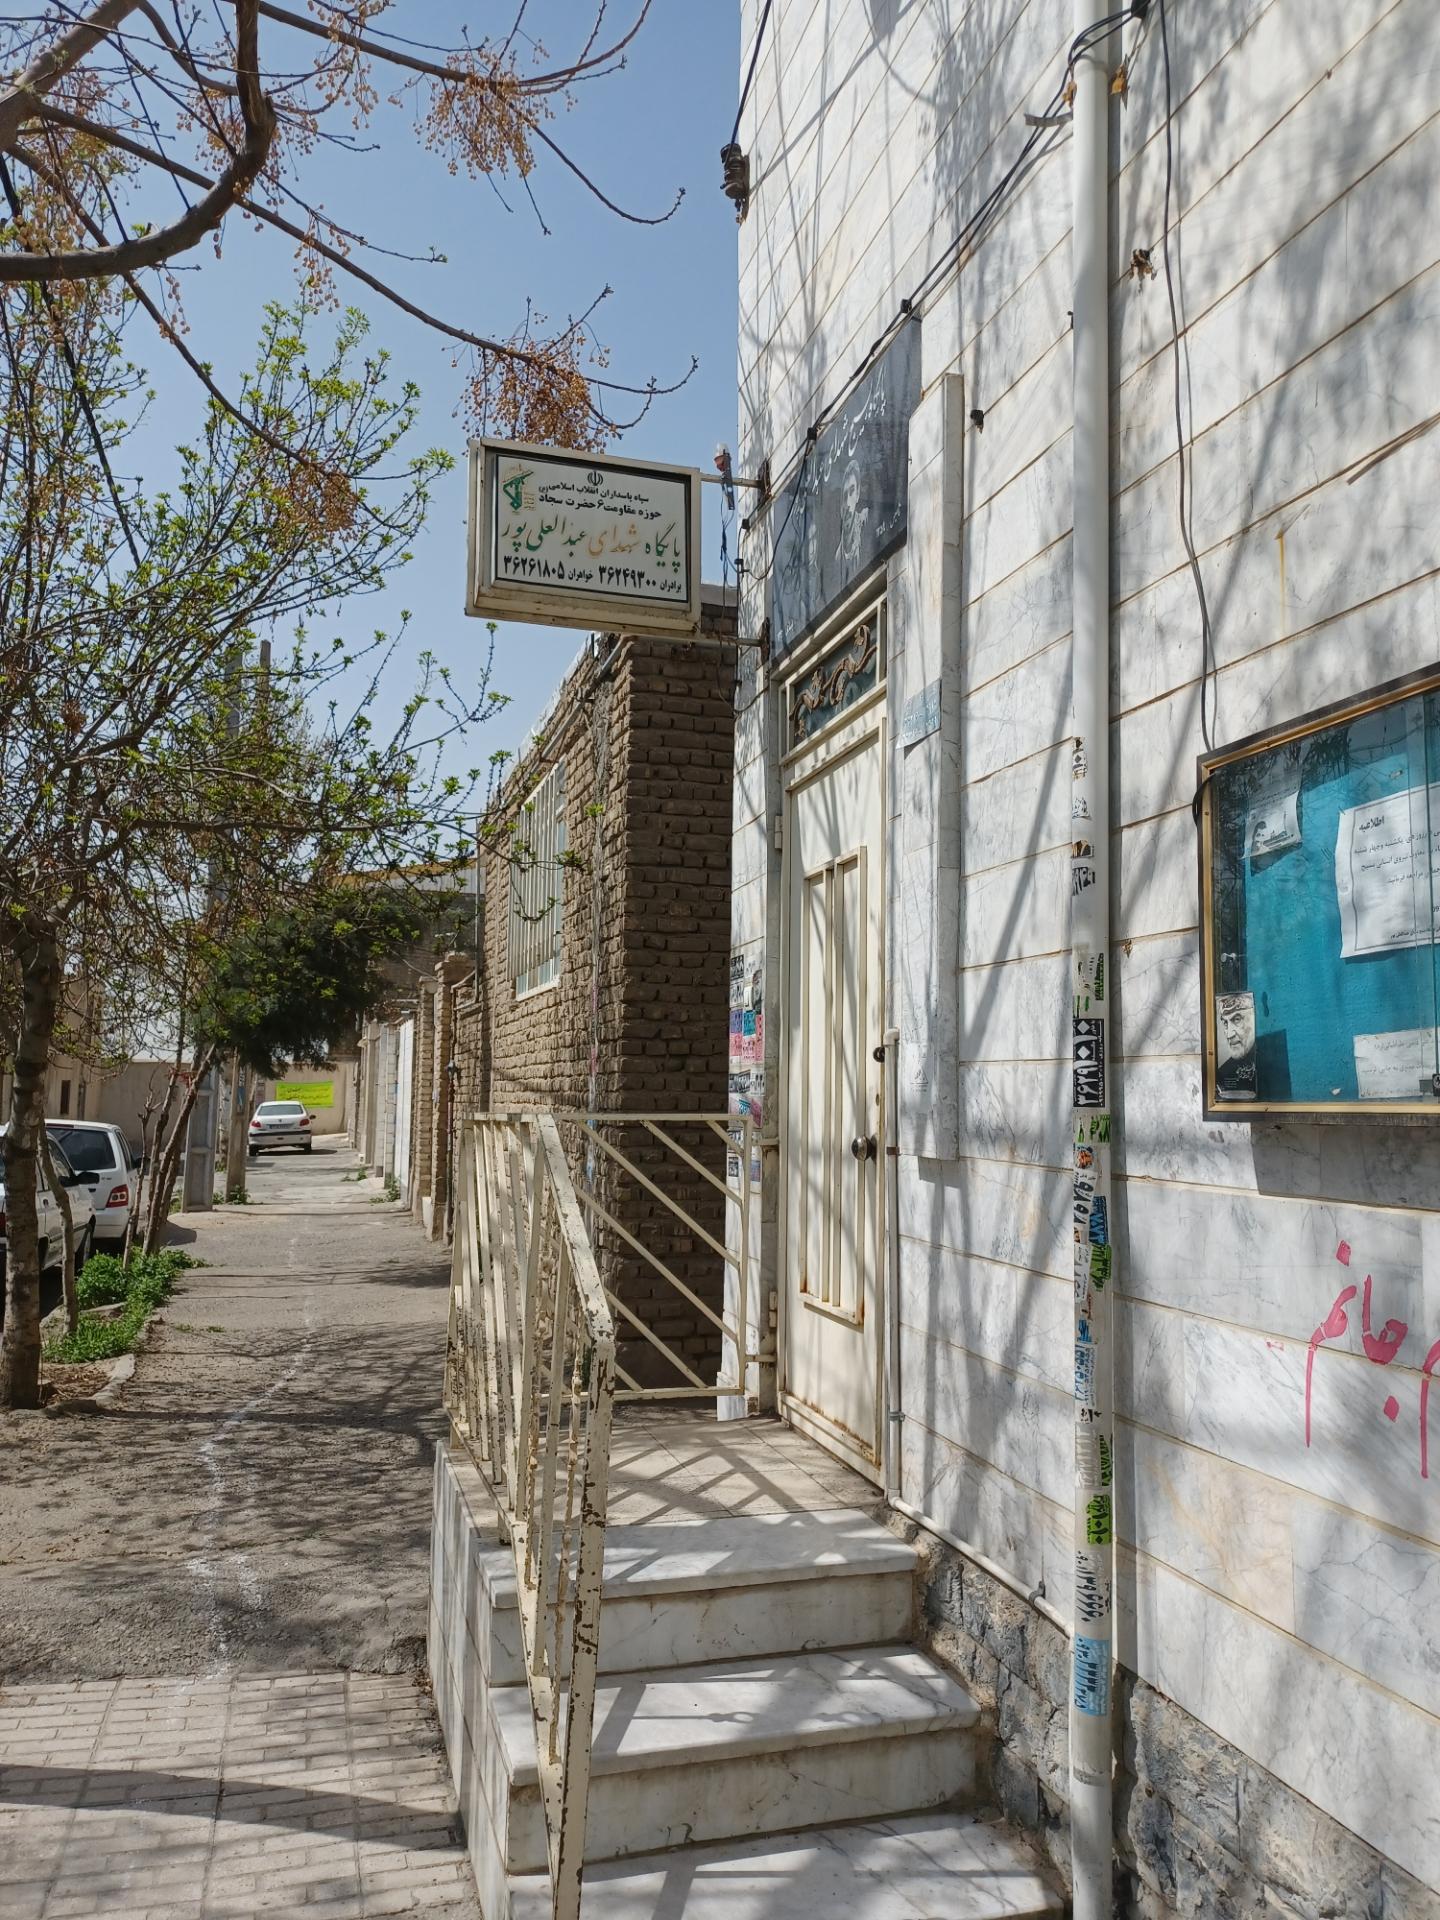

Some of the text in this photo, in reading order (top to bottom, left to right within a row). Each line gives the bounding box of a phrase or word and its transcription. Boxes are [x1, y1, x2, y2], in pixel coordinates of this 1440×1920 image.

[538, 493, 563, 507] سجاد
[548, 482, 649, 504] سپاه پاسداران انقلاب اسلامی
[565, 498, 597, 510] حضرت
[603, 504, 636, 516] مقاومت
[638, 509, 662, 520] حوزه
[501, 521, 527, 552] پور
[588, 523, 641, 557] شهدای
[645, 522, 681, 573] پایگاه
[504, 555, 565, 579] ۳۶۲۶۱۸۰۵
[568, 568, 593, 583] خواهران
[659, 579, 682, 593] برادران
[1359, 815, 1385, 832] اطلاعیه
